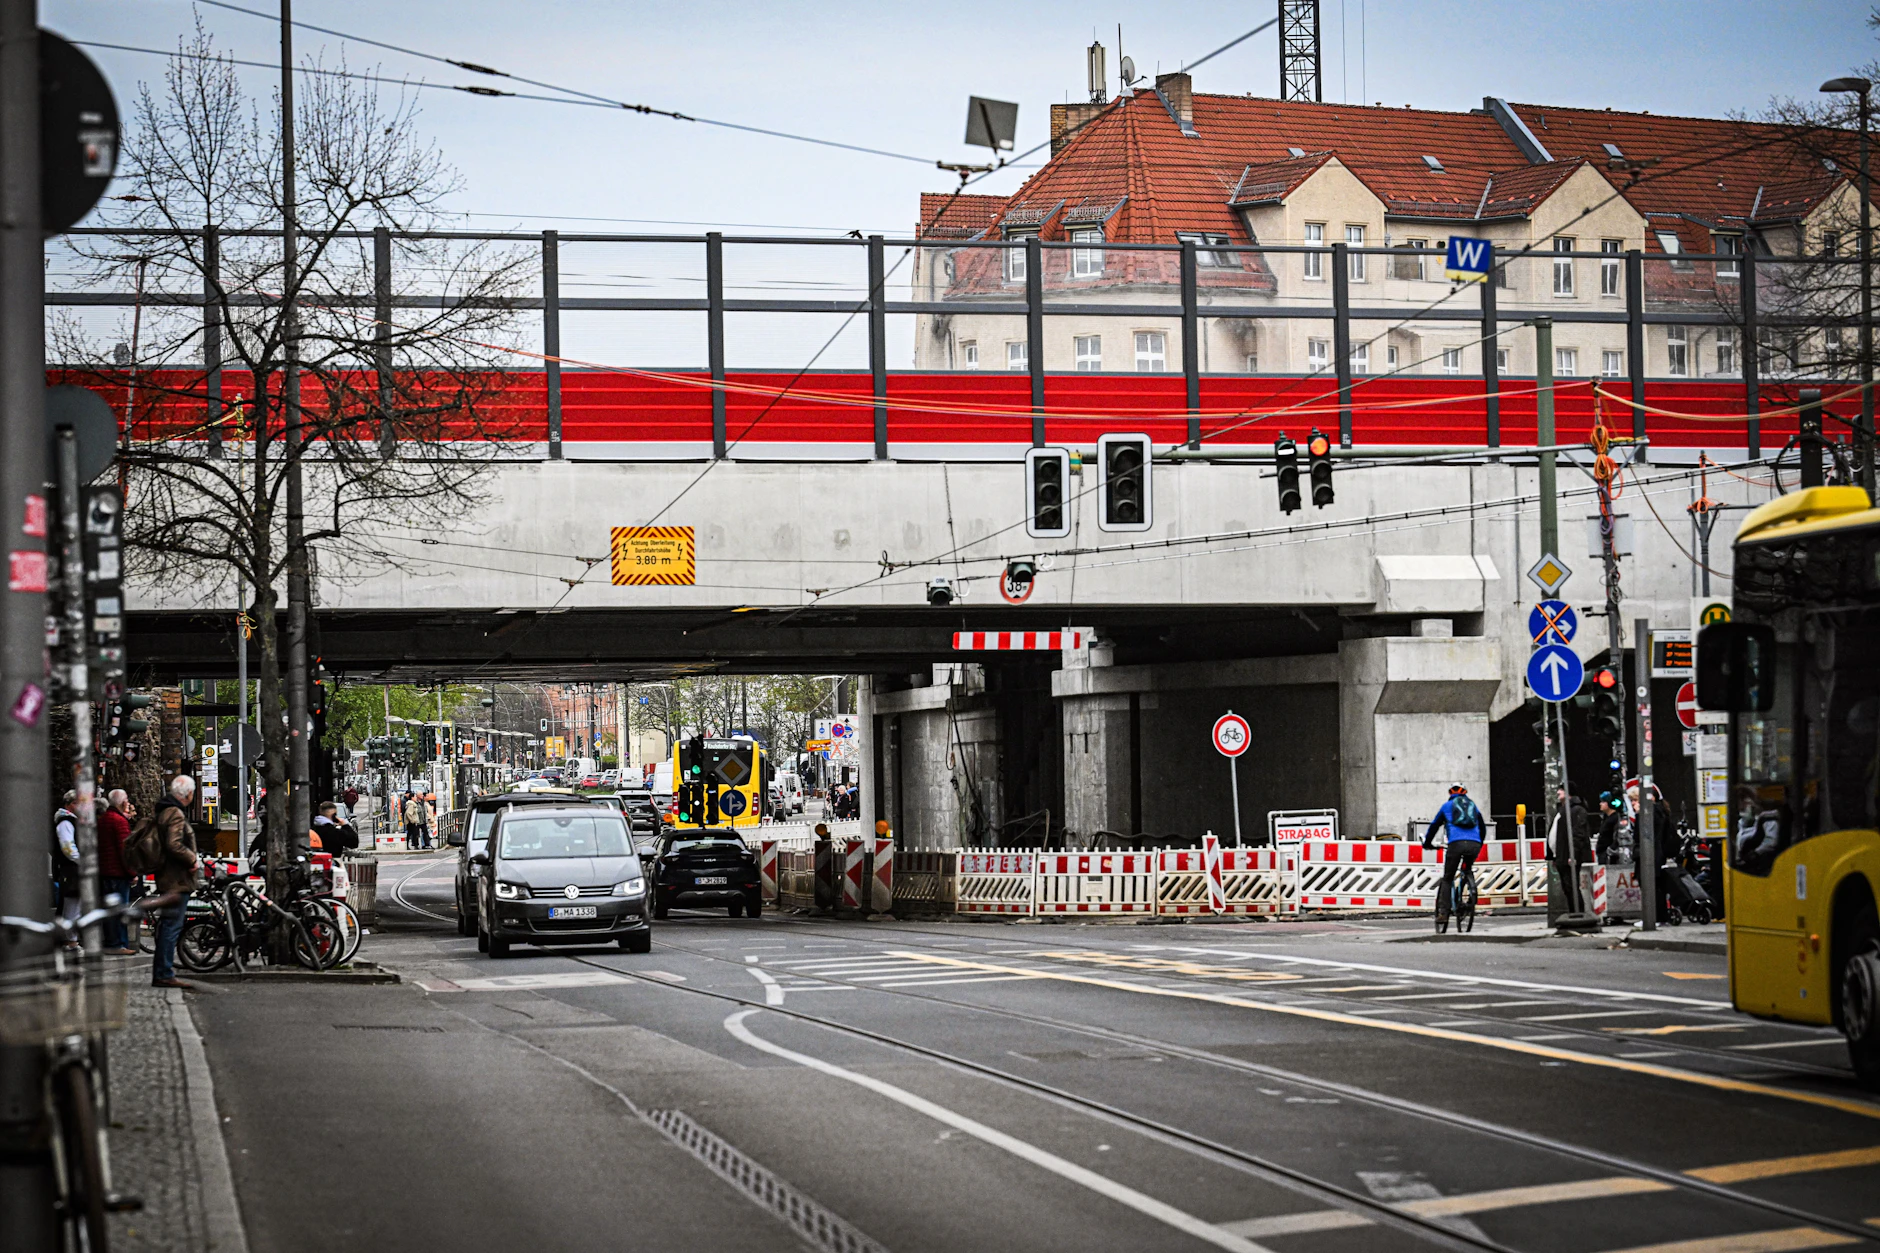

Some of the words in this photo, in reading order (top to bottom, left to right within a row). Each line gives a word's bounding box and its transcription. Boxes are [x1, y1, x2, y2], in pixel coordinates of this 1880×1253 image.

[1455, 240, 1485, 269] W
[661, 557, 671, 565] m
[1278, 827, 1330, 840] STRABAG
[553, 908, 559, 917] B
[563, 908, 574, 916] MA
[576, 907, 595, 916] 1338
